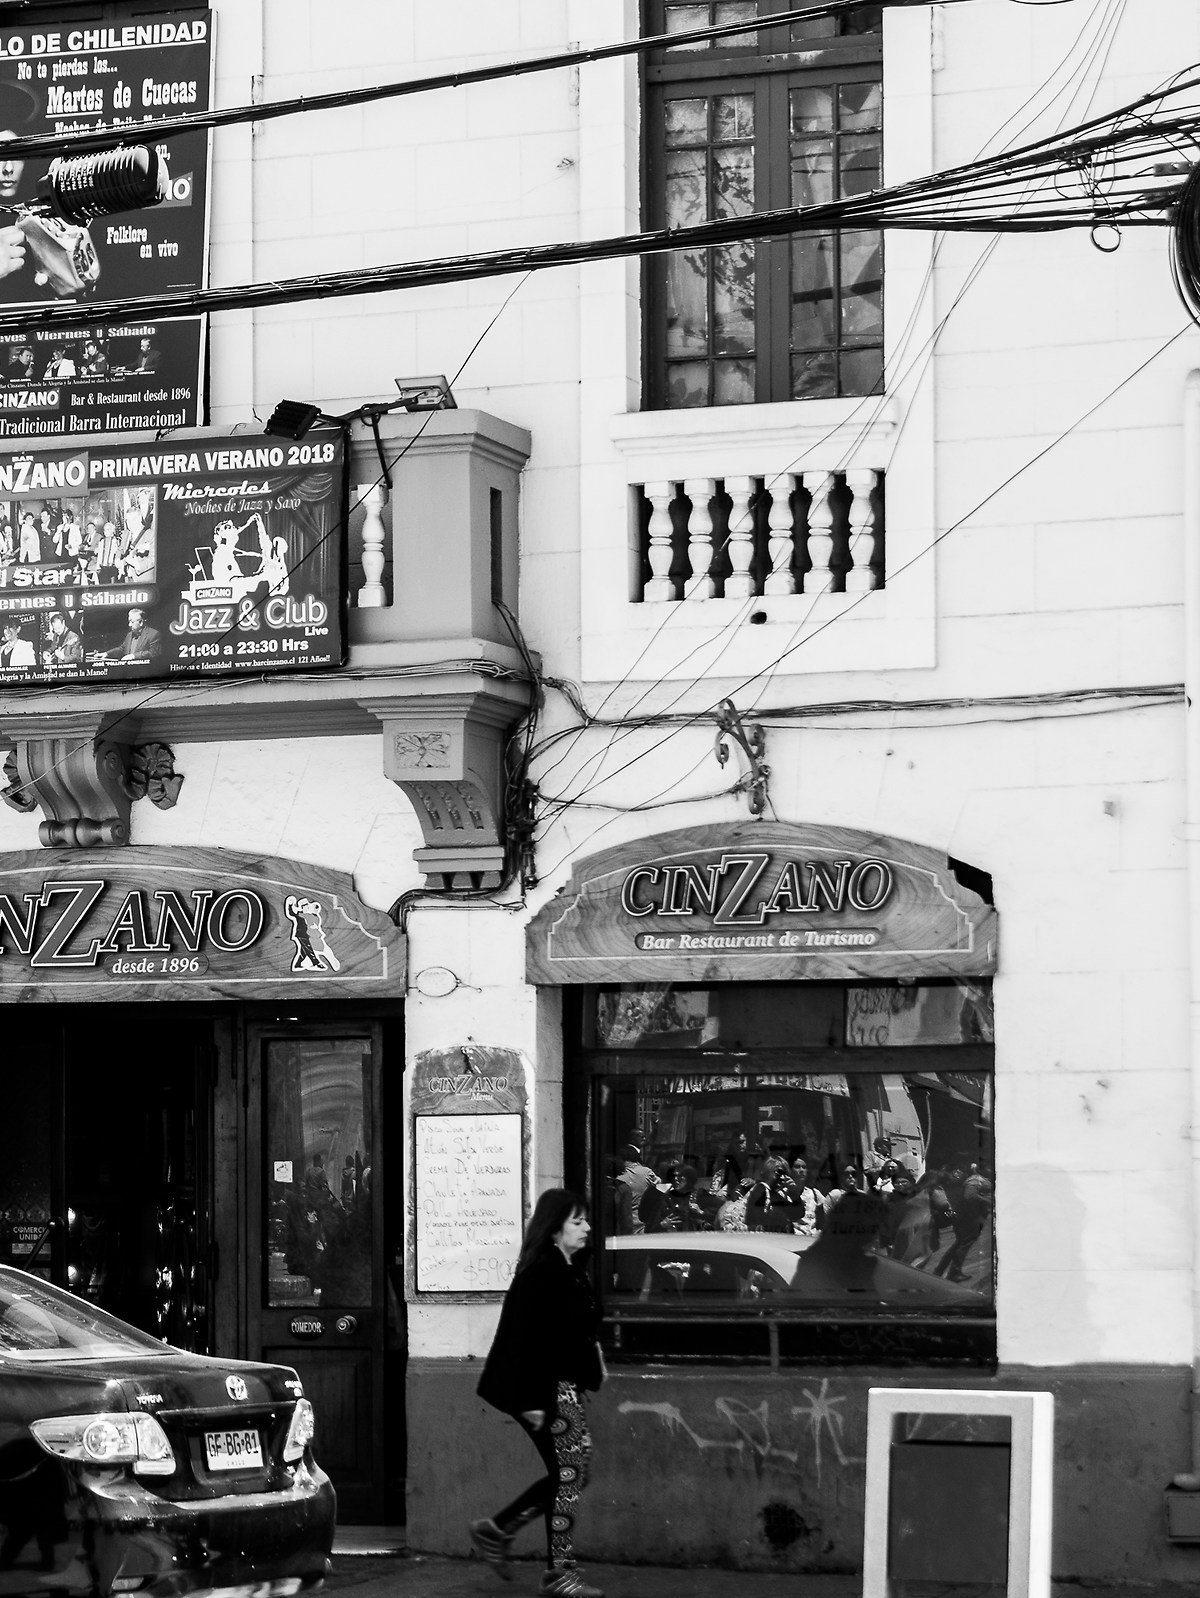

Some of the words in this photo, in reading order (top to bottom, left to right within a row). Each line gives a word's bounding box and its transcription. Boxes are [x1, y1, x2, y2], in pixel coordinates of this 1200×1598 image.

[31, 33, 61, 54] DE
[67, 21, 207, 51] CHILENIDAD
[17, 62, 31, 80] No
[37, 61, 47, 78] te
[52, 58, 88, 81] pierdas
[93, 57, 118, 74] los...
[46, 85, 103, 114] Martes
[113, 81, 132, 108] de
[142, 78, 197, 106] Cuecas
[106, 226, 147, 245] Folklore
[140, 244, 153, 259] en
[158, 240, 178, 257] vivo
[36, 329, 91, 341] Viernes
[107, 324, 156, 338] Sábado
[71, 394, 84, 406] Bar
[87, 392, 95, 405] &
[96, 390, 142, 405] Restaurant
[143, 389, 168, 403] desde
[170, 386, 191, 401] 1896
[69, 413, 101, 432] Barra
[105, 409, 186, 430] Internacional
[11, 455, 34, 463] BAR
[89, 453, 201, 479] PRIMAVERA
[204, 447, 284, 471] VERANO
[287, 443, 335, 466] 2018
[162, 480, 272, 501] Miercoles
[184, 499, 224, 516] Noches
[224, 499, 237, 515] de
[238, 498, 264, 515] Jazz
[265, 500, 274, 514] y
[275, 496, 301, 511] Saxo
[12, 566, 72, 586] Star
[81, 590, 149, 606] Sábado
[196, 587, 232, 599] CINZANO
[174, 605, 232, 631] Jazz
[238, 604, 259, 627] &
[266, 595, 325, 625] Club
[305, 626, 329, 636] Live
[178, 642, 220, 658] 21:00
[223, 644, 233, 655] a
[236, 639, 279, 654] 23:30
[282, 638, 309, 652] Hrs
[19, 674, 24, 682] y
[25, 672, 30, 680] la
[66, 669, 78, 678] dan
[79, 668, 85, 677] la
[201, 661, 232, 669] Identidad
[621, 852, 894, 926] CINZANO
[642, 934, 676, 950] Bar
[679, 932, 775, 949] Restaurant
[778, 931, 799, 946] de
[804, 929, 876, 946] Turismo
[112, 956, 157, 975] desde
[160, 955, 200, 974] 1896
[427, 1074, 508, 1095] CINZANO
[13, 1226, 47, 1234] COMERCI
[291, 1321, 322, 1333] COMEDOR
